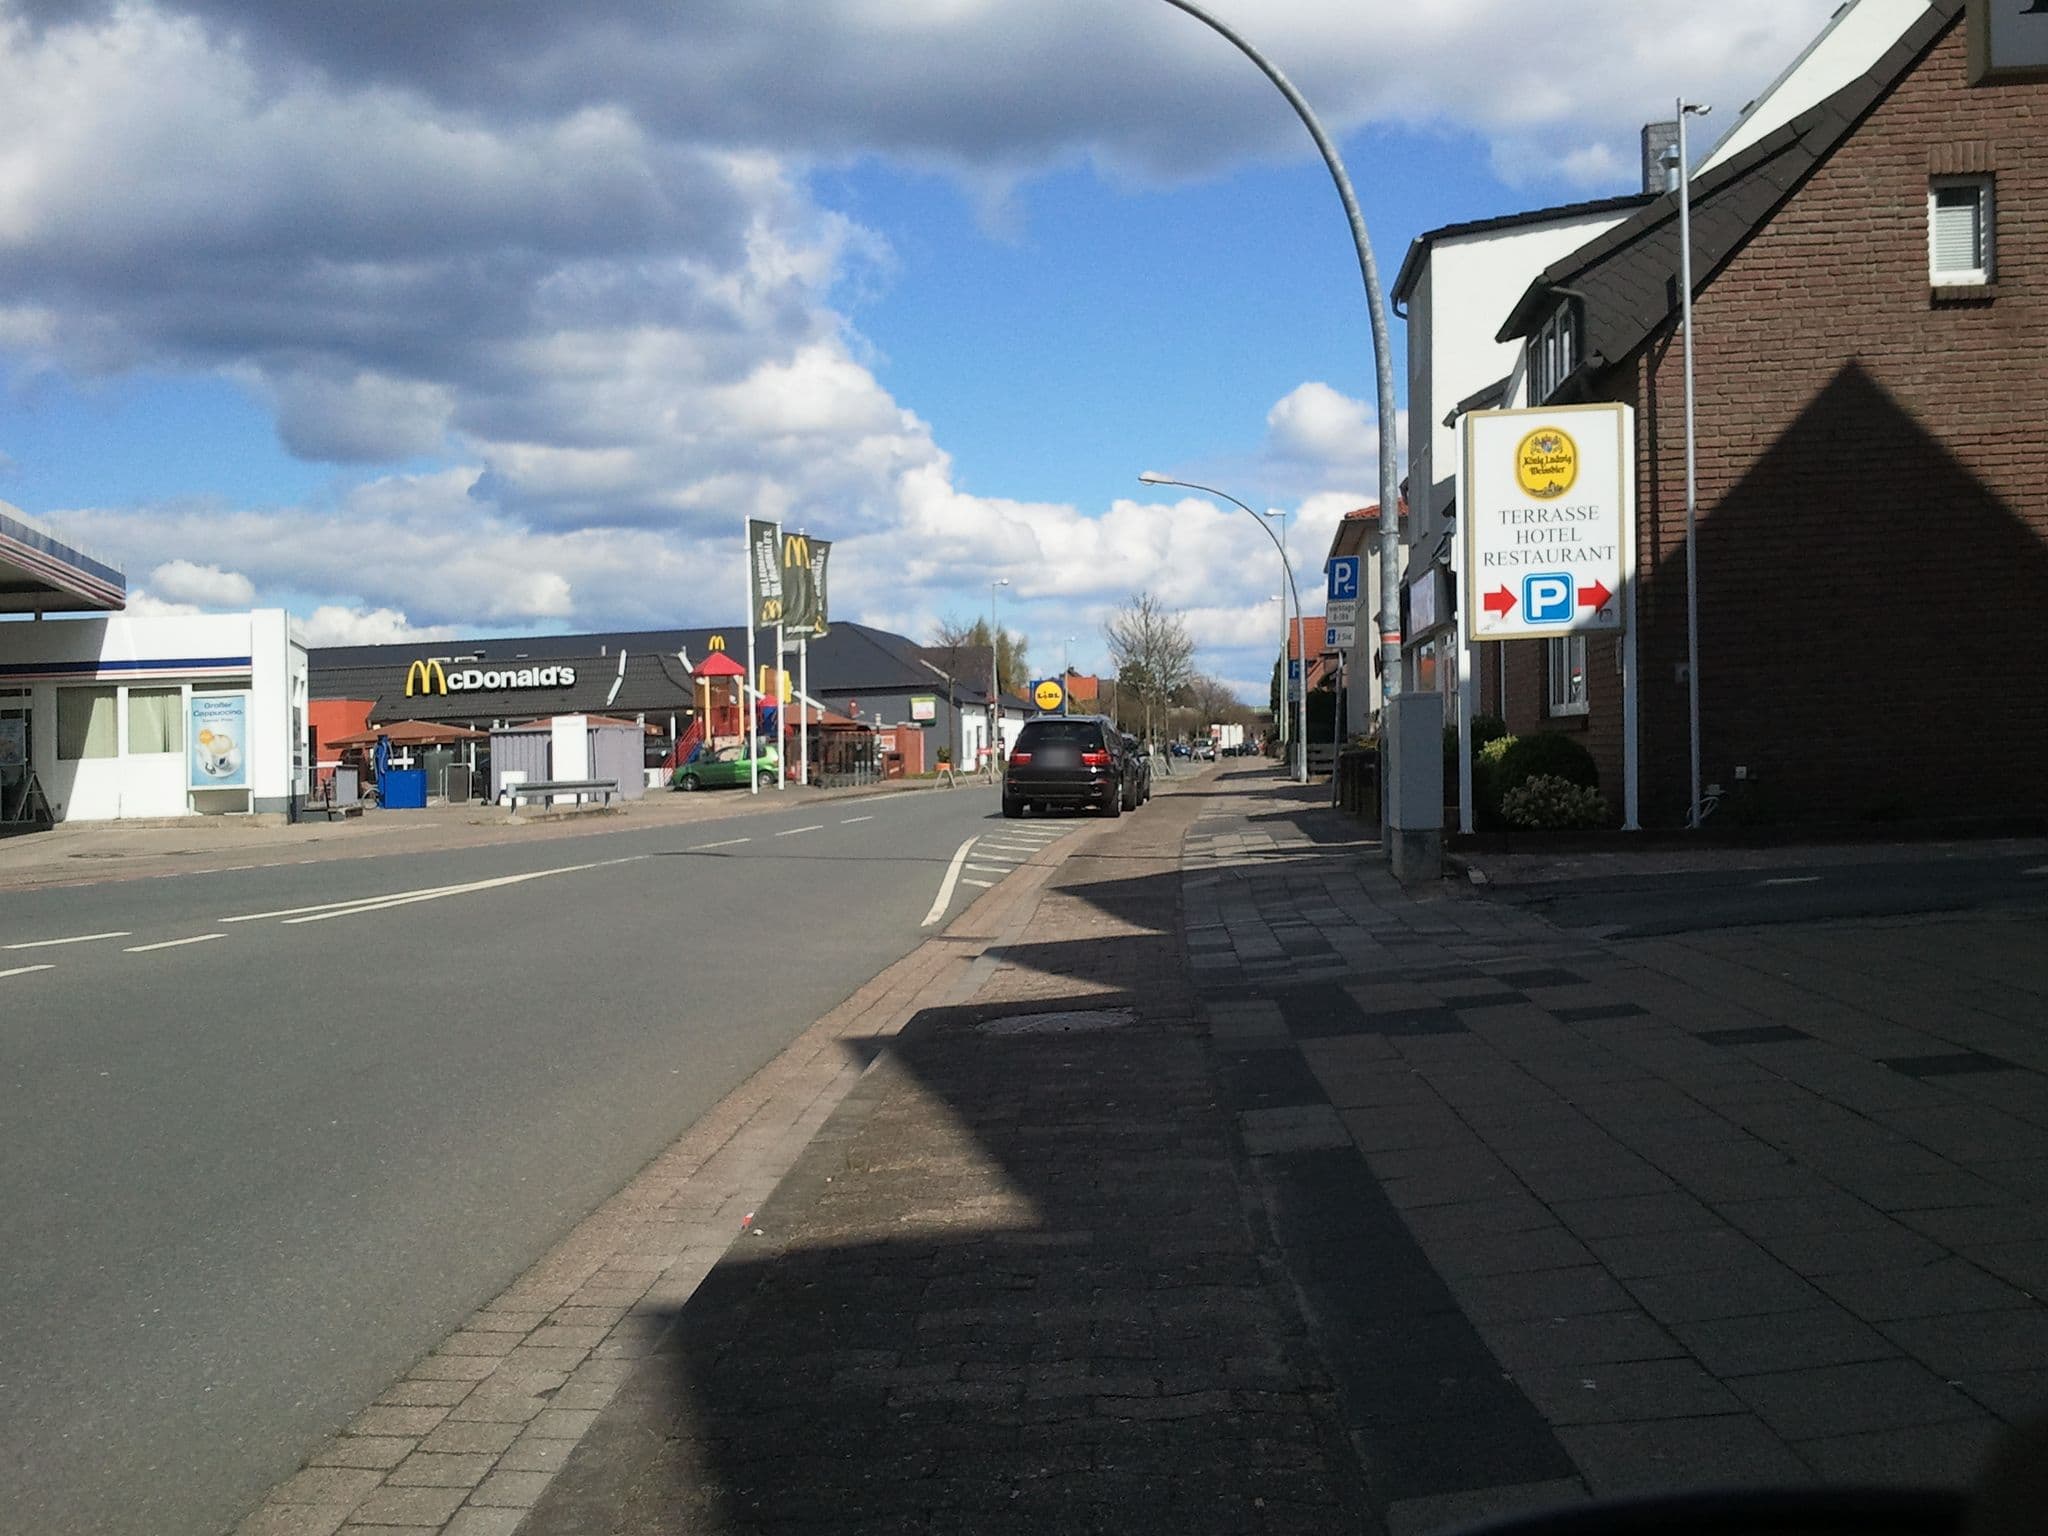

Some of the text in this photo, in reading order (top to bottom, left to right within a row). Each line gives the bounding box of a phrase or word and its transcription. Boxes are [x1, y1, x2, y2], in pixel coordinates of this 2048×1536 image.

[1498, 505, 1600, 525] TERRASSE
[1515, 527, 1583, 545] HOTEL
[1483, 545, 1617, 567] RESTAURANT
[1334, 562, 1351, 596] P
[1530, 578, 1568, 618] P
[405, 659, 576, 697] McDonald's
